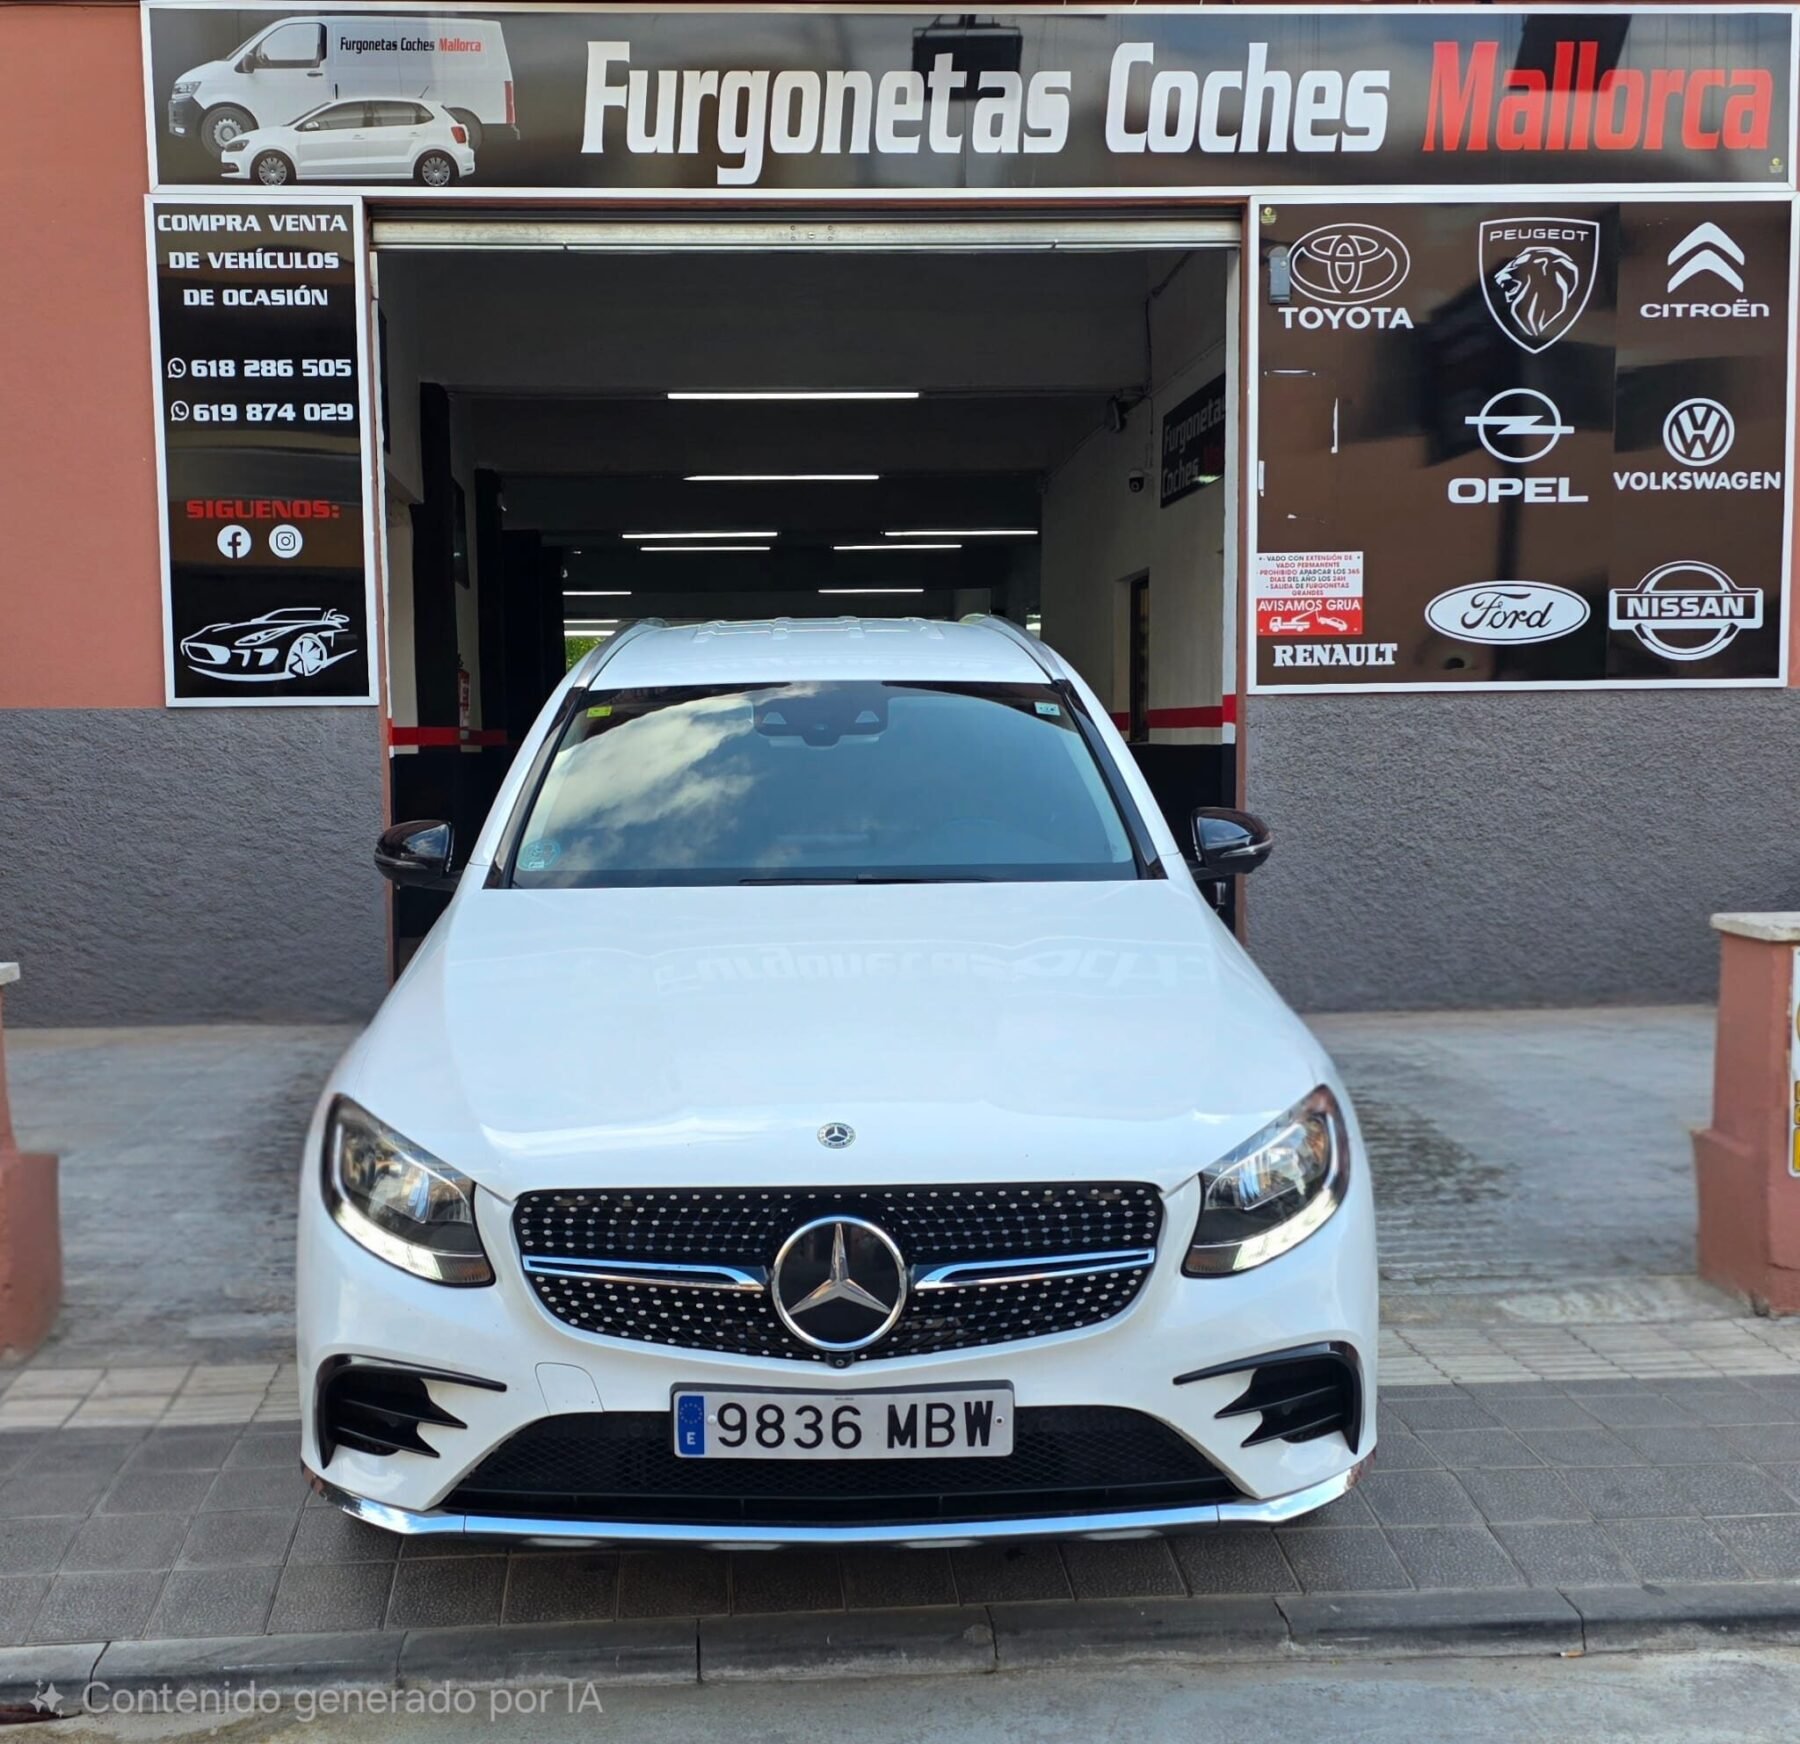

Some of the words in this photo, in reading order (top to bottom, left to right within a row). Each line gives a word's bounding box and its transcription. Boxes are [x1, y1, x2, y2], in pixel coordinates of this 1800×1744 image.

[340, 37, 397, 54] Furgonetas
[401, 37, 435, 51] Coches
[439, 37, 481, 52] Mallorca
[581, 41, 1071, 185] Furgonetas
[1105, 42, 1390, 153] Coches
[1422, 41, 1773, 152] Mallorca
[157, 214, 261, 232] COMPRA
[268, 214, 348, 232] VENTA
[1490, 227, 1588, 243] PEUGEOT
[168, 252, 199, 269] DE
[207, 248, 340, 269] VEHÍCULOS
[183, 289, 215, 306] DE
[222, 285, 328, 306] OCASIÓN
[1278, 306, 1413, 330] TOYOTA
[1639, 299, 1770, 318] CITROËN
[191, 359, 236, 378] 618
[243, 359, 294, 378] 286
[302, 359, 352, 378] 505
[193, 403, 238, 422] 619
[246, 403, 296, 422] 874
[304, 403, 354, 422] 029
[1447, 477, 1589, 503] OPEL
[1613, 471, 1781, 490] VOLKSWAGEN
[186, 499, 341, 519] SIGUENOS:
[1258, 600, 1322, 611] AVISAMOS
[1326, 599, 1361, 611] GRUA
[1461, 591, 1554, 630] Ford
[1626, 597, 1744, 617] NISSAN
[1272, 643, 1398, 667] RENAULT
[686, 1432, 696, 1445] E
[717, 1402, 862, 1450] 9836
[887, 1400, 994, 1449] MBW
